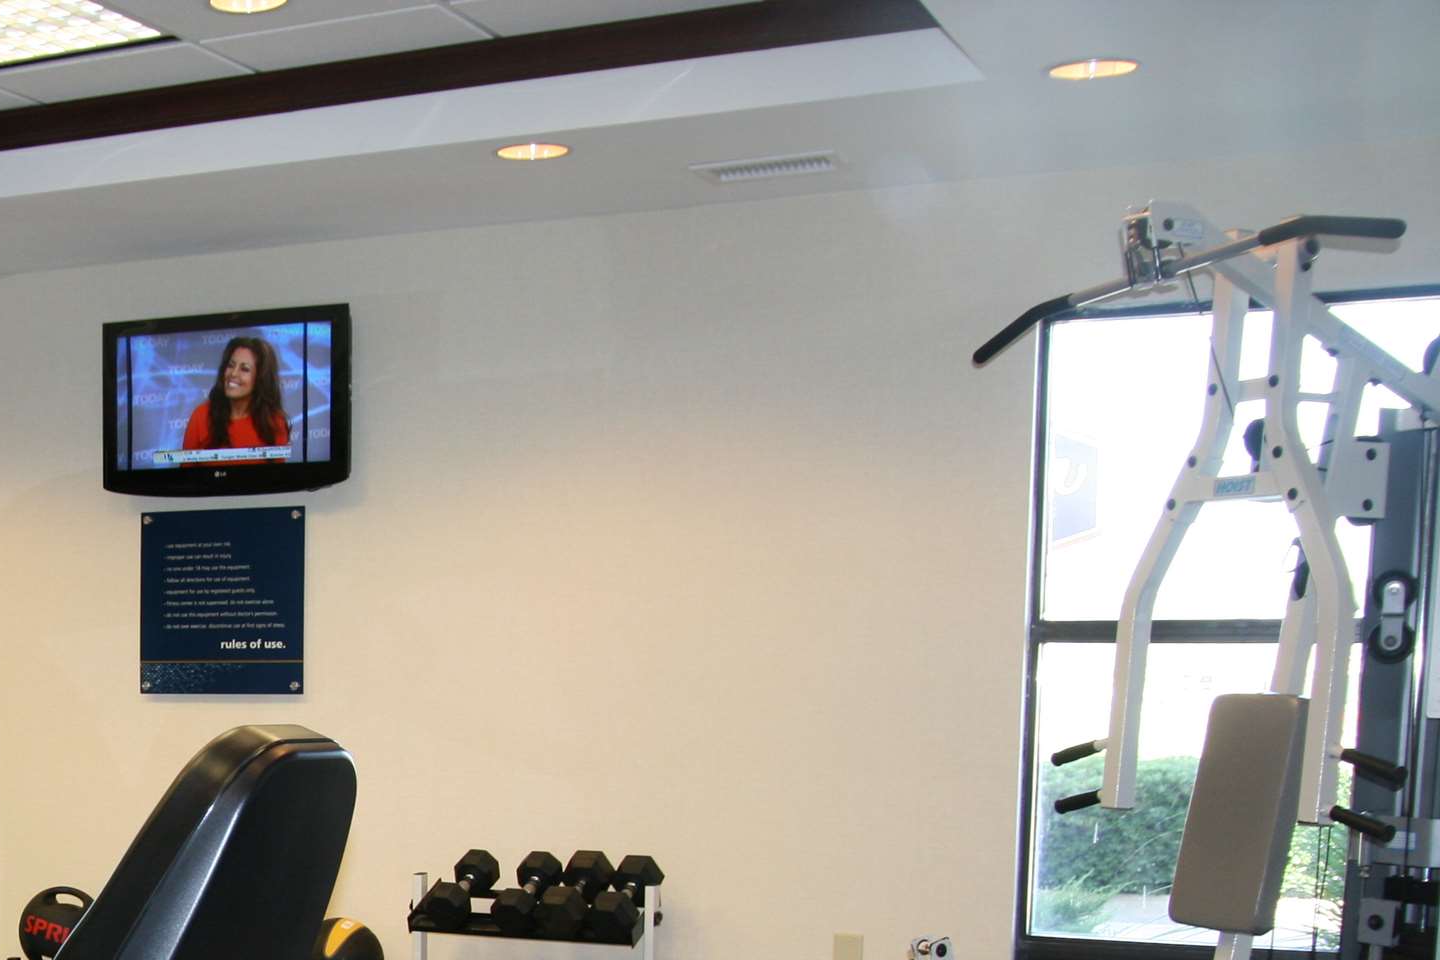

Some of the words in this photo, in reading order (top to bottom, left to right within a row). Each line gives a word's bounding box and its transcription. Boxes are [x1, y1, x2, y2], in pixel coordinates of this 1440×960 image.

[220, 639, 247, 649] rules
[249, 638, 262, 649] of
[264, 641, 286, 649] use.
